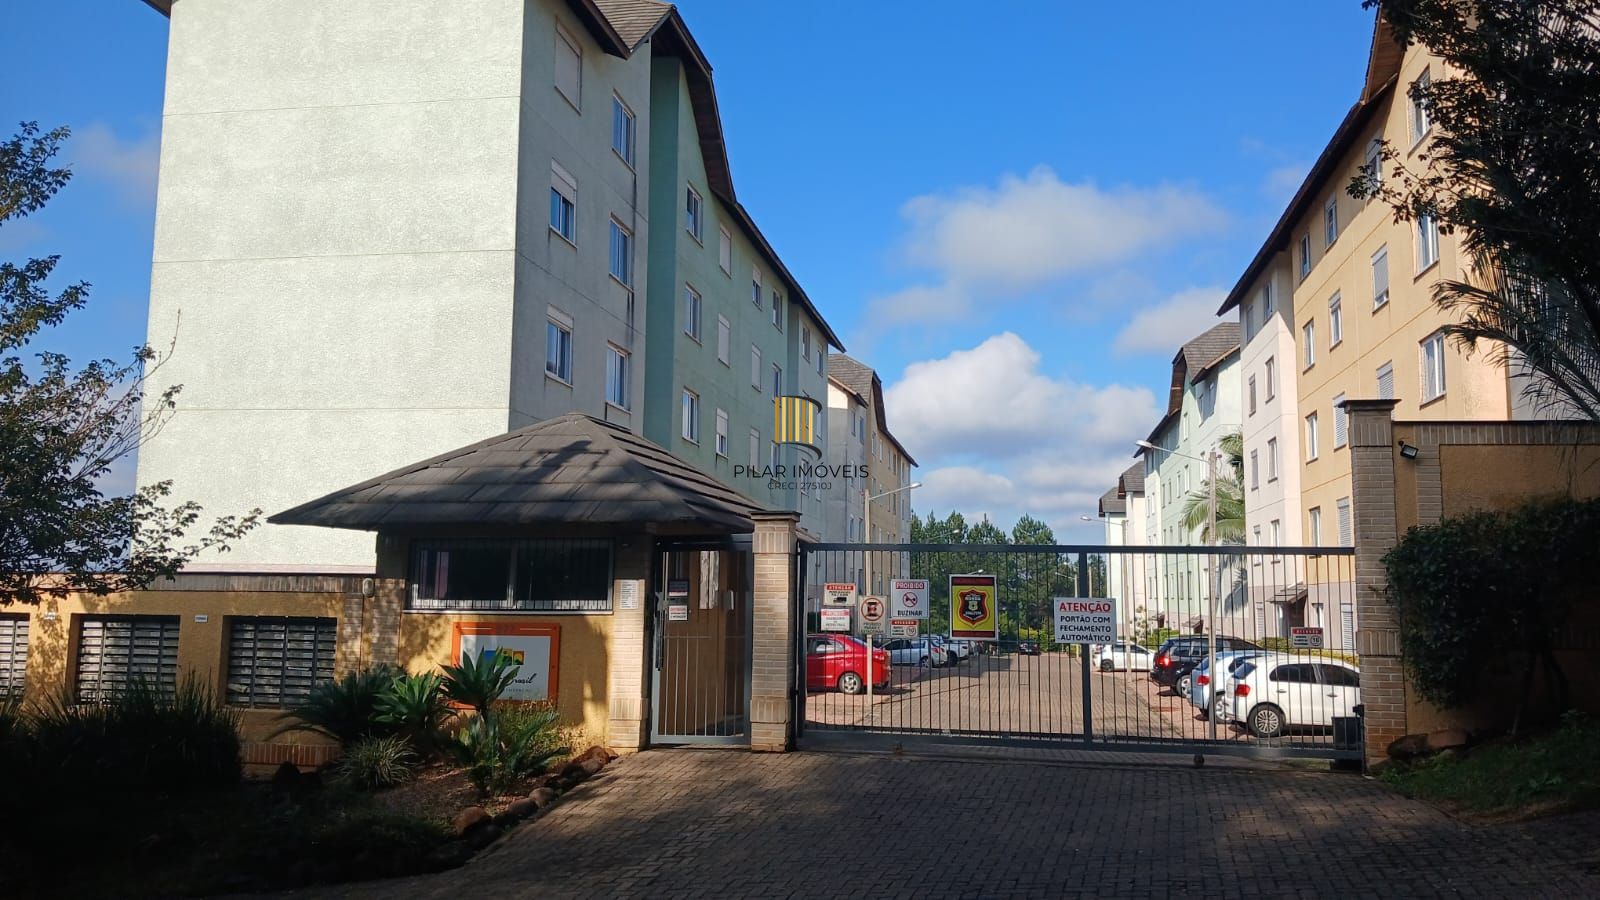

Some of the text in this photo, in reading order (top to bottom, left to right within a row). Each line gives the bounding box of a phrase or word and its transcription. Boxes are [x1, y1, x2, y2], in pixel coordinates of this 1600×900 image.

[1059, 600, 1112, 614] ATENÇÃO
[1060, 615, 1090, 623] PORTÃO
[1060, 633, 1111, 641] AUTOMÁTICO
